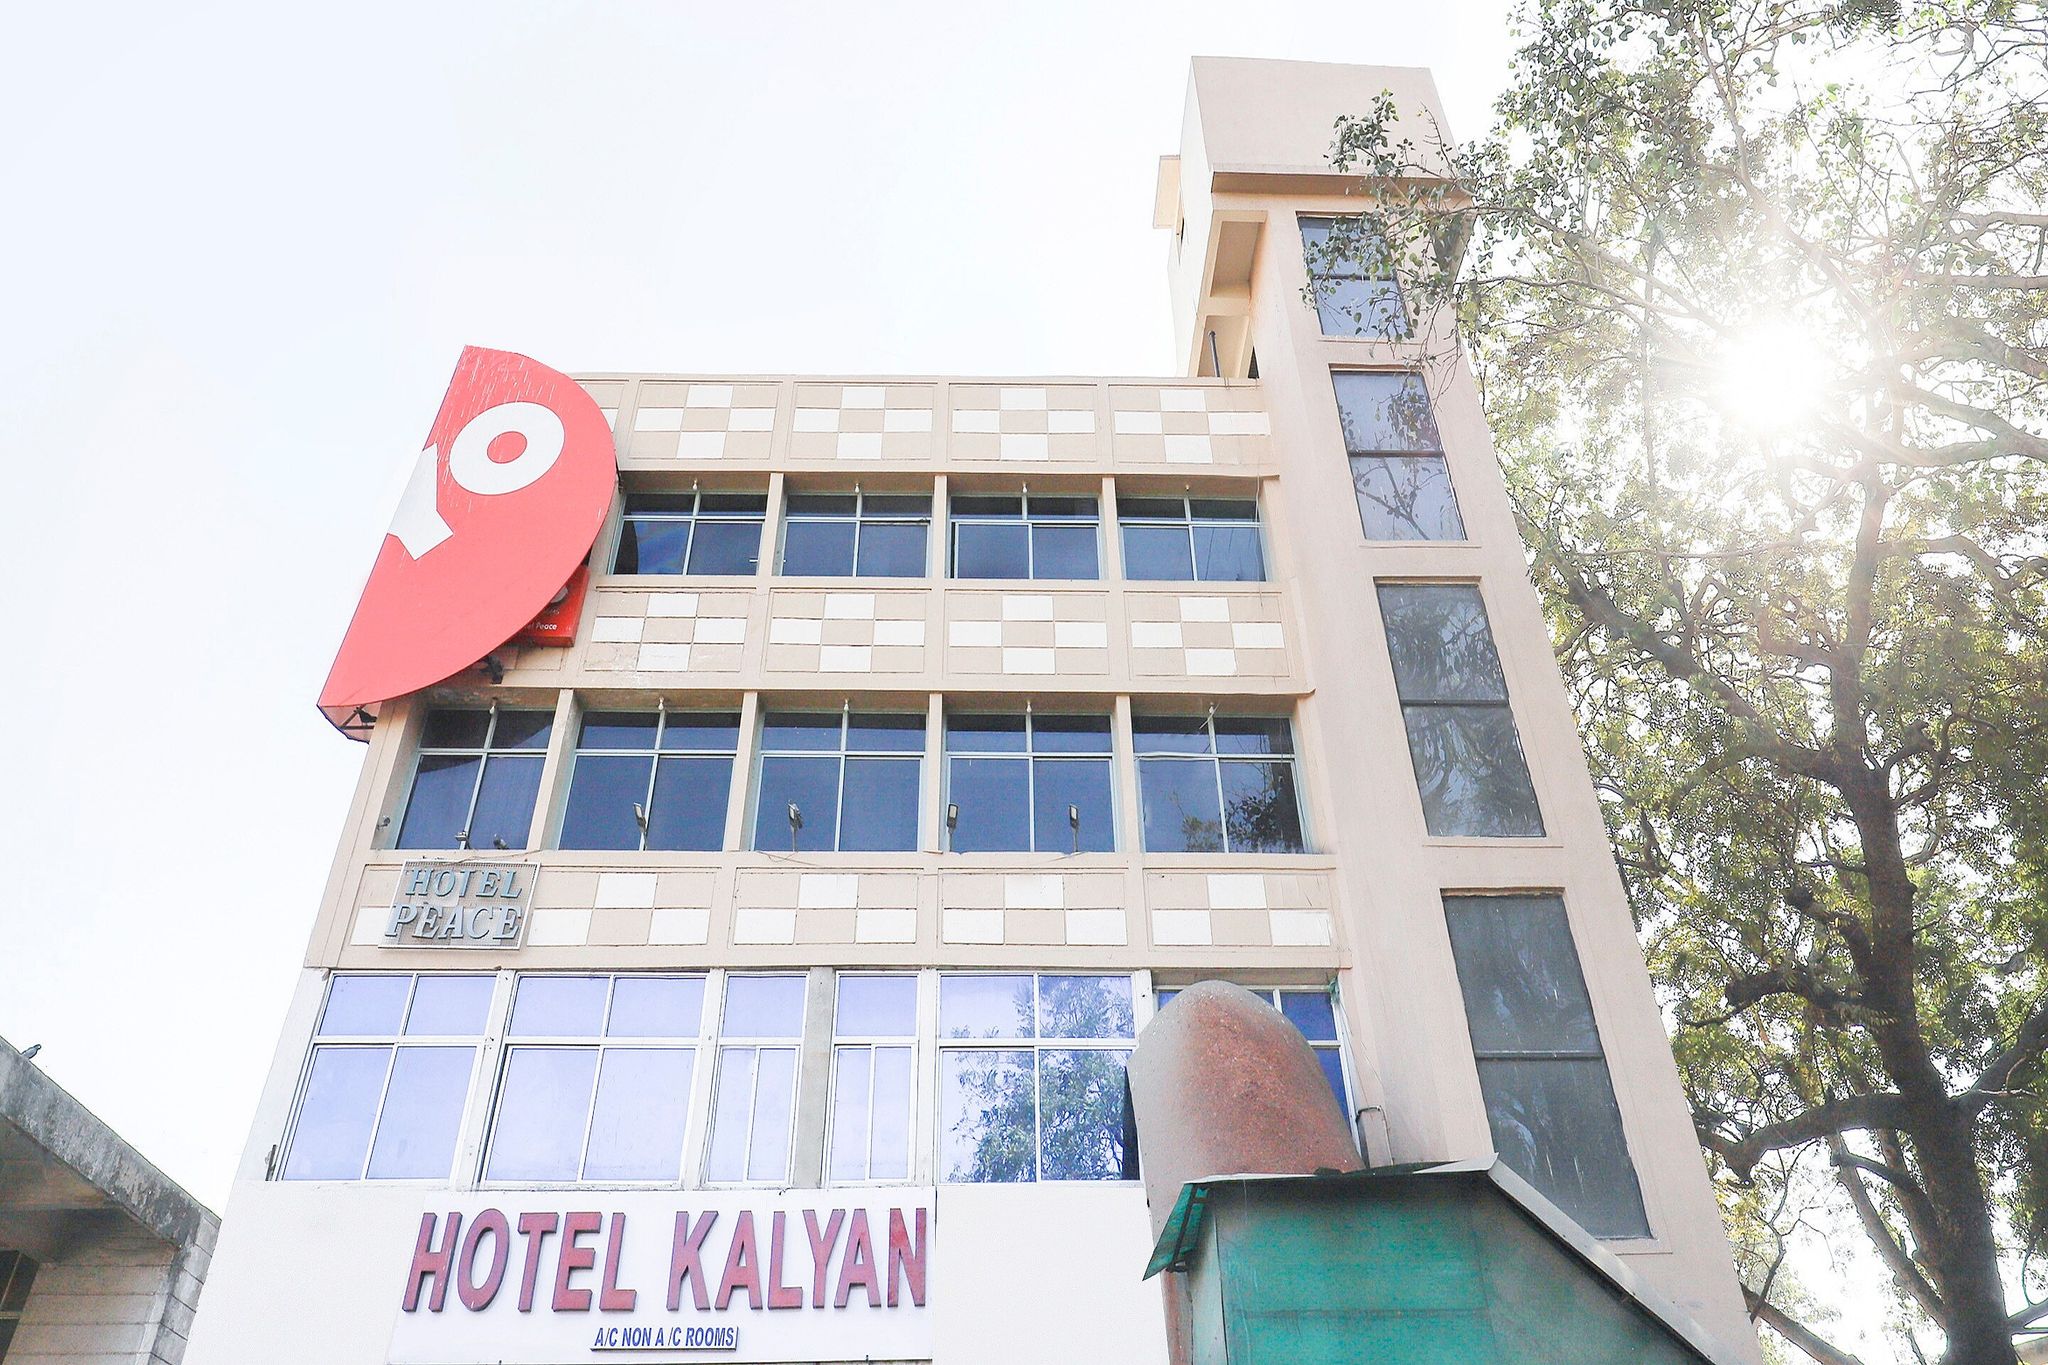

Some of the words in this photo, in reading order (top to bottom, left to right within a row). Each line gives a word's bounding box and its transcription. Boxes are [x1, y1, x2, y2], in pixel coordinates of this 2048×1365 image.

[405, 867, 522, 899] HOTEL
[385, 902, 523, 940] PEACE
[402, 1208, 637, 1312] HOTEL
[666, 1208, 926, 1311] KALYAN
[594, 1327, 618, 1347] A/C
[621, 1327, 652, 1347] NON
[685, 1326, 734, 1347] ROOMS
